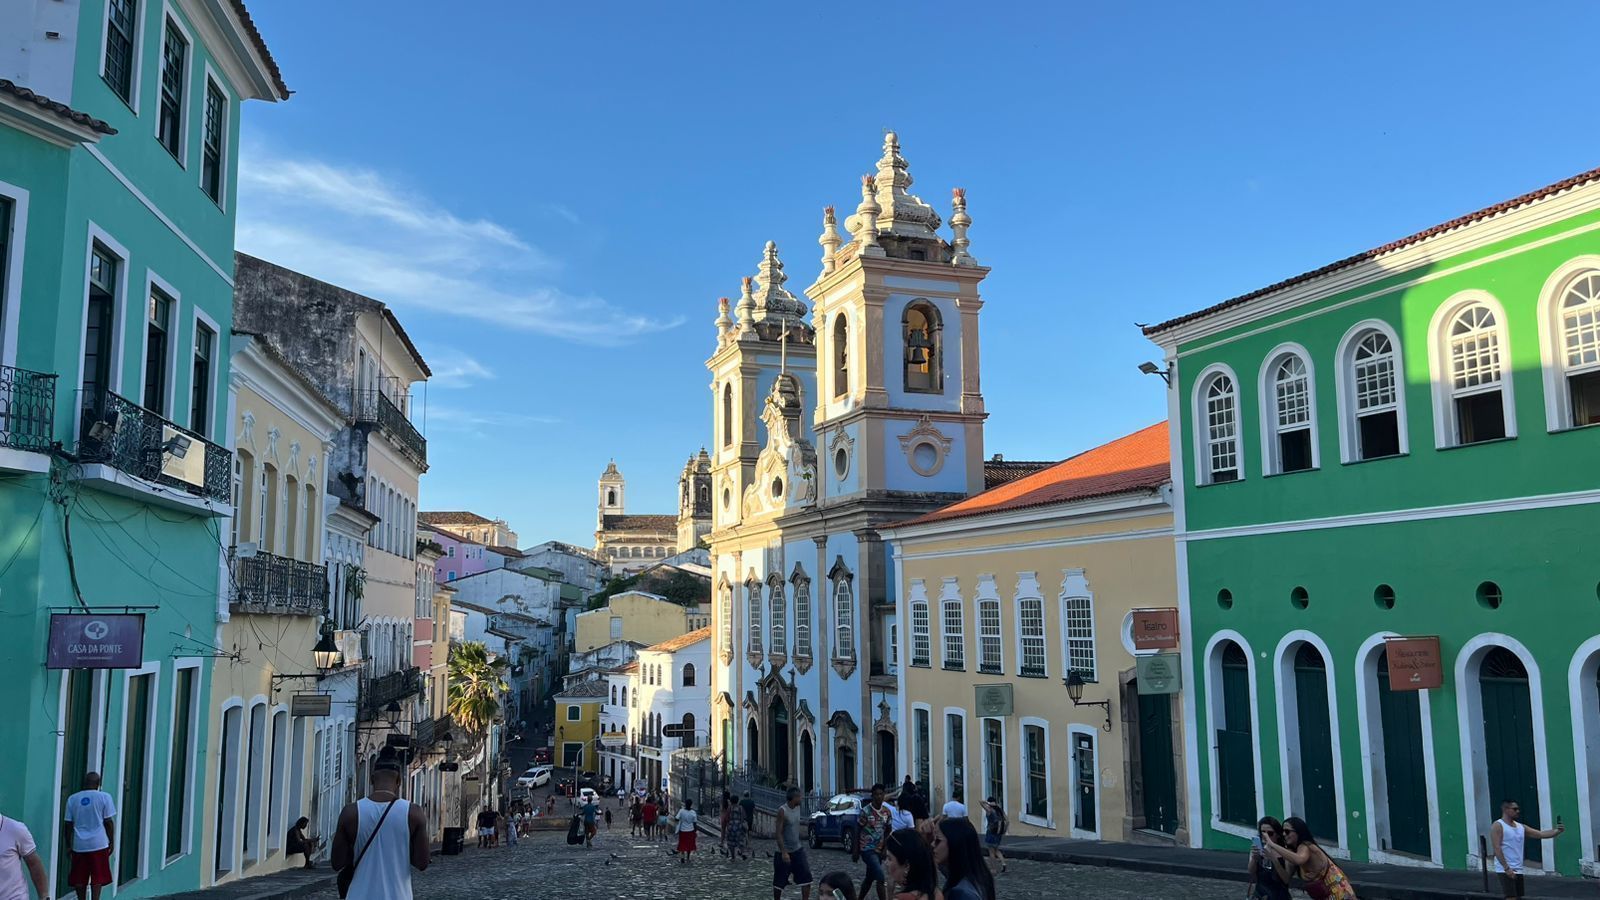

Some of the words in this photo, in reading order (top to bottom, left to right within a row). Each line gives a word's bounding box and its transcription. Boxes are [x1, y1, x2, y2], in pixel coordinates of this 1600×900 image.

[1141, 620, 1167, 631] Teatro
[68, 644, 87, 653] CASA
[88, 644, 98, 653] DA
[99, 644, 123, 653] PONTE
